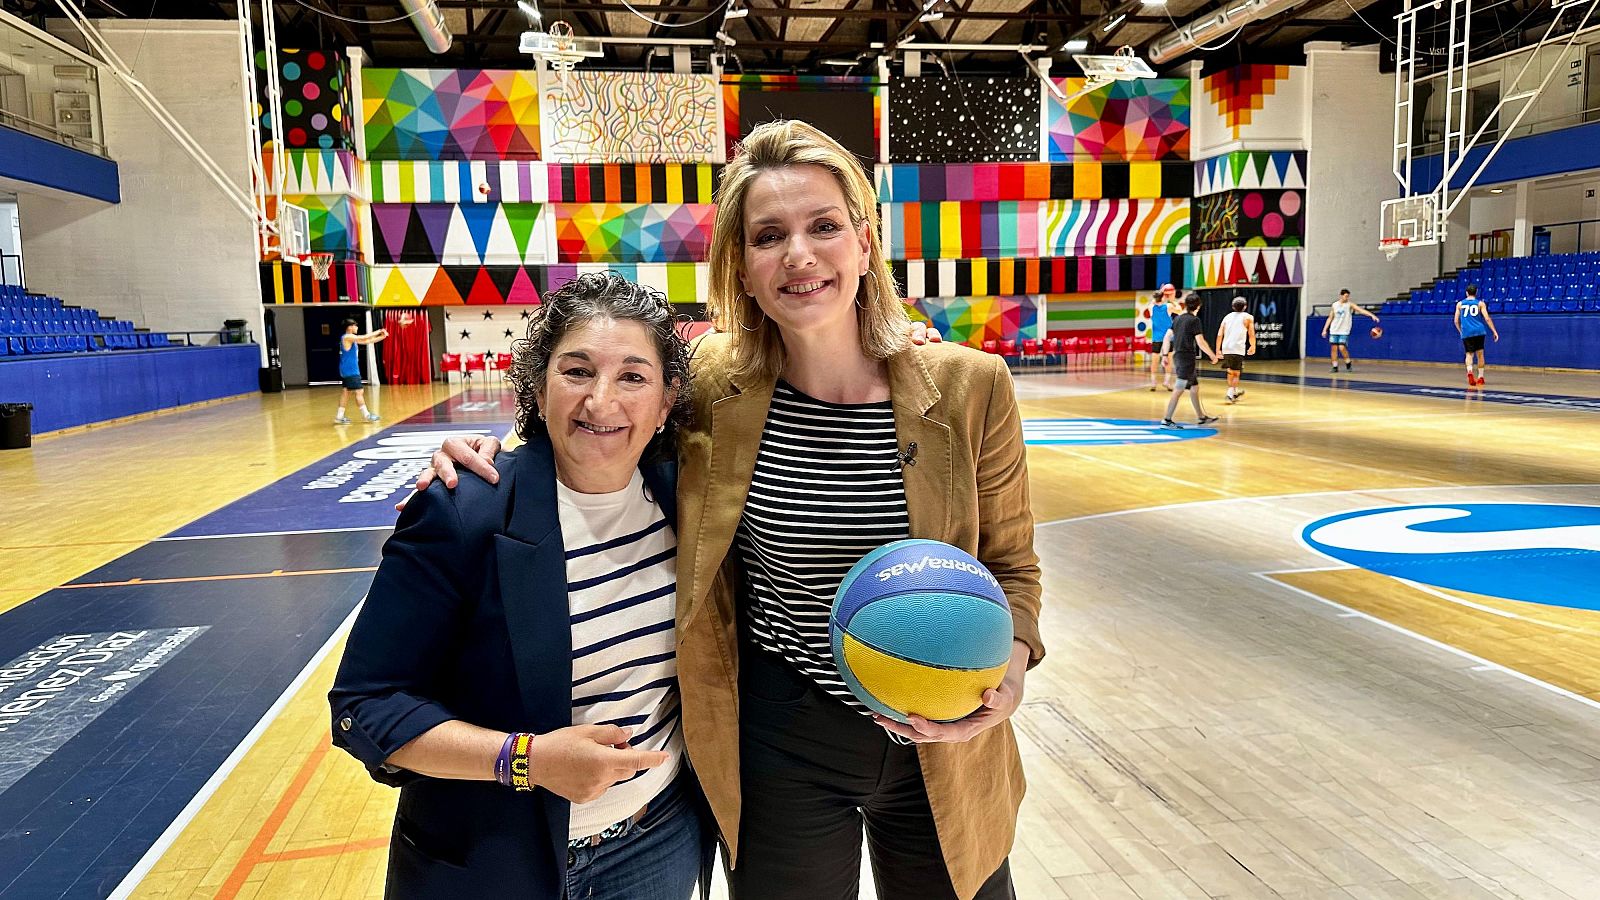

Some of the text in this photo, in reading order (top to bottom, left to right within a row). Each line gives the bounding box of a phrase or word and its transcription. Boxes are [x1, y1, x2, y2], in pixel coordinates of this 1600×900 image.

[1461, 304, 1478, 317] 70
[57, 630, 148, 666] Díaz
[89, 681, 127, 703] Grupo
